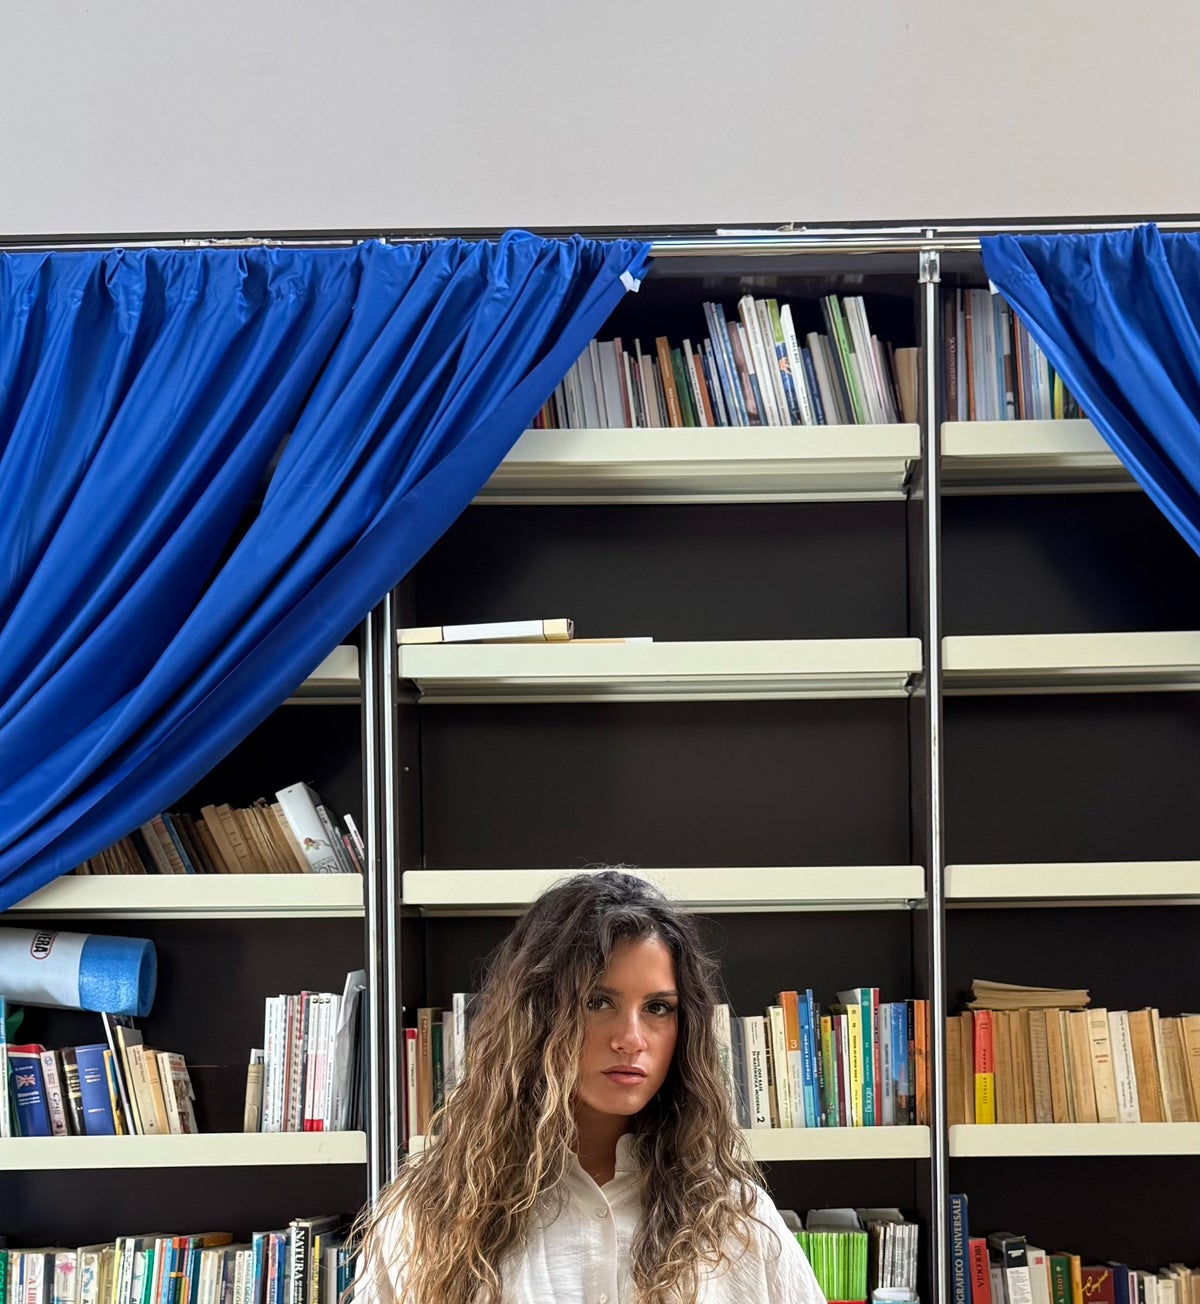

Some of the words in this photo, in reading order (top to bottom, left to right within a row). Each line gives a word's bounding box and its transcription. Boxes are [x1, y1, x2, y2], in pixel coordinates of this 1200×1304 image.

[790, 1039, 798, 1049] 3
[952, 1198, 963, 1256] UNIVERSALE
[294, 1230, 305, 1280] NATURA
[974, 1245, 984, 1288] BIOLOGIA
